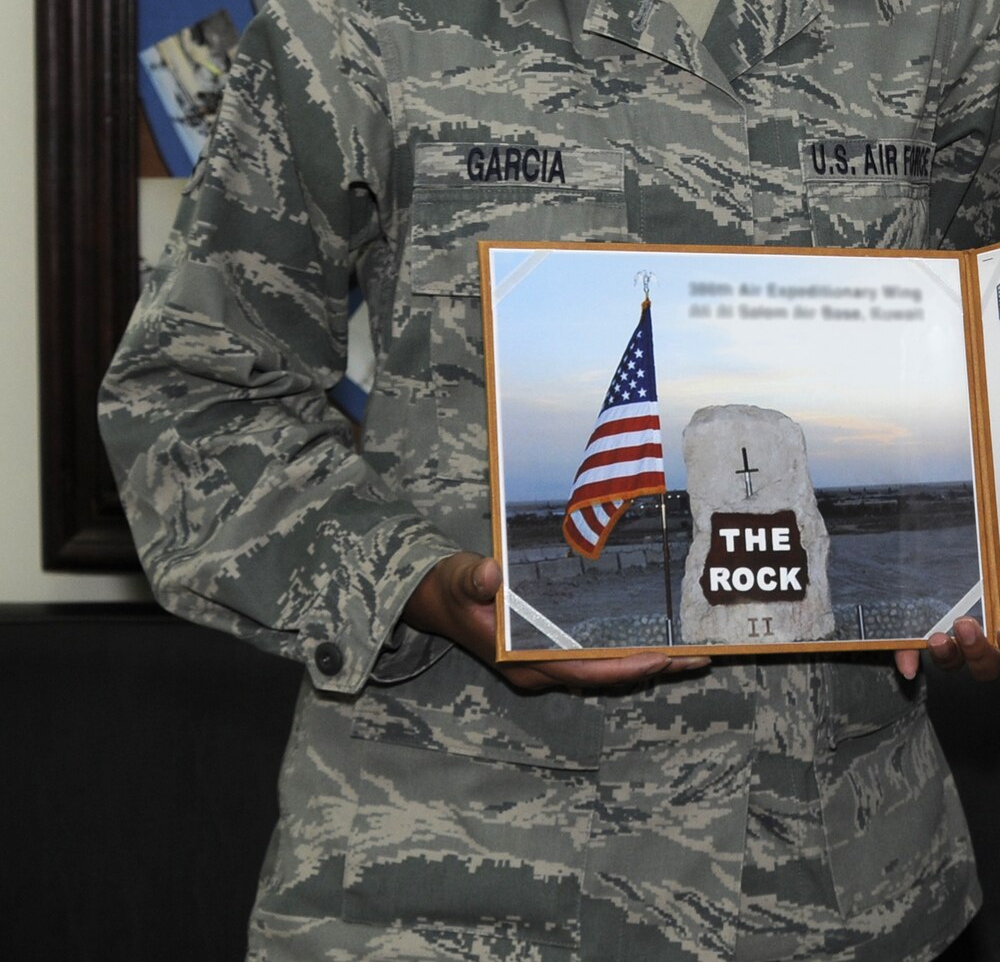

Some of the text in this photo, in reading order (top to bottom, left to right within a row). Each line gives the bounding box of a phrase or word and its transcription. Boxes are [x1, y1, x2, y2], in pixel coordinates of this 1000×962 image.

[466, 147, 566, 184] GARCIA
[812, 143, 856, 176] U.S.
[864, 143, 898, 176] AIR
[719, 527, 791, 552] THE
[709, 566, 802, 592] ROCK
[748, 617, 774, 638] II
